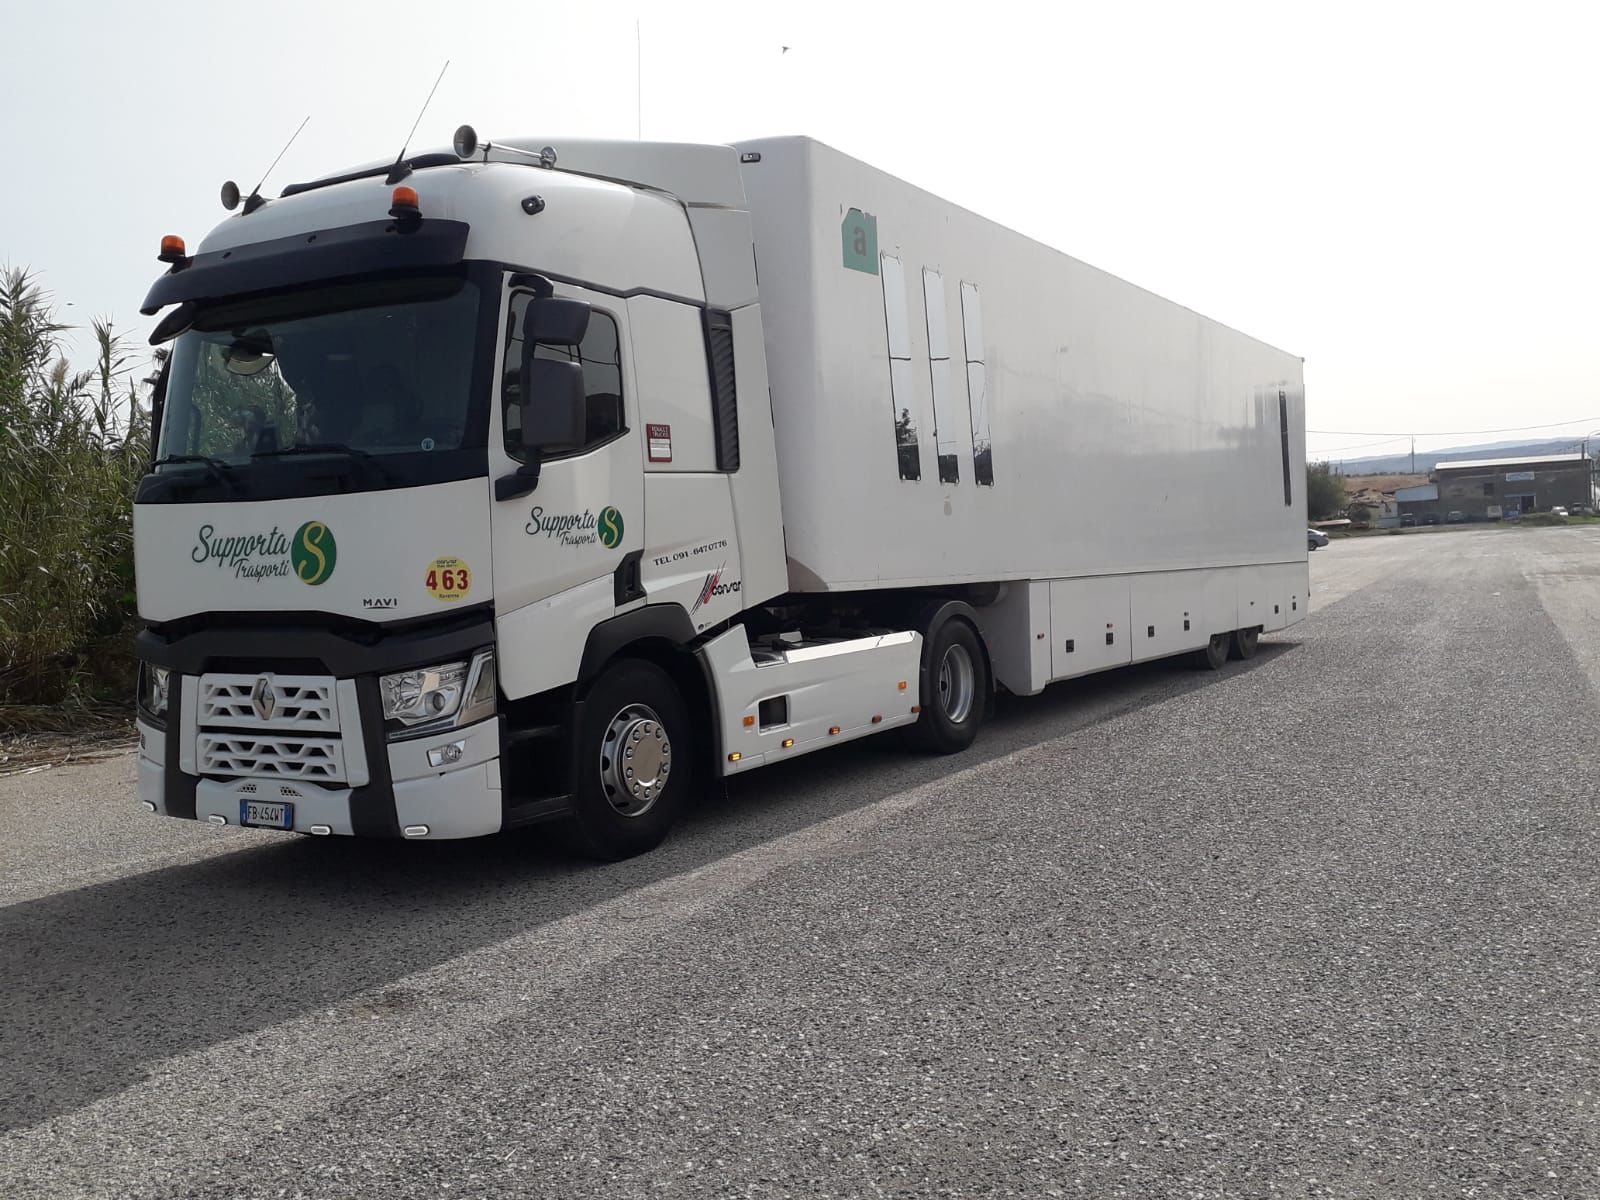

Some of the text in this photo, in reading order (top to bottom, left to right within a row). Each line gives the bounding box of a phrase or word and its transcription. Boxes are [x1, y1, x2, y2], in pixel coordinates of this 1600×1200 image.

[526, 506, 597, 538] Supporta
[192, 525, 291, 567] Supporta
[560, 531, 597, 548] Trasporti
[233, 558, 290, 582] Trasporti
[653, 556, 672, 566] TEL
[426, 569, 468, 591] 463
[363, 598, 398, 607] MAVI
